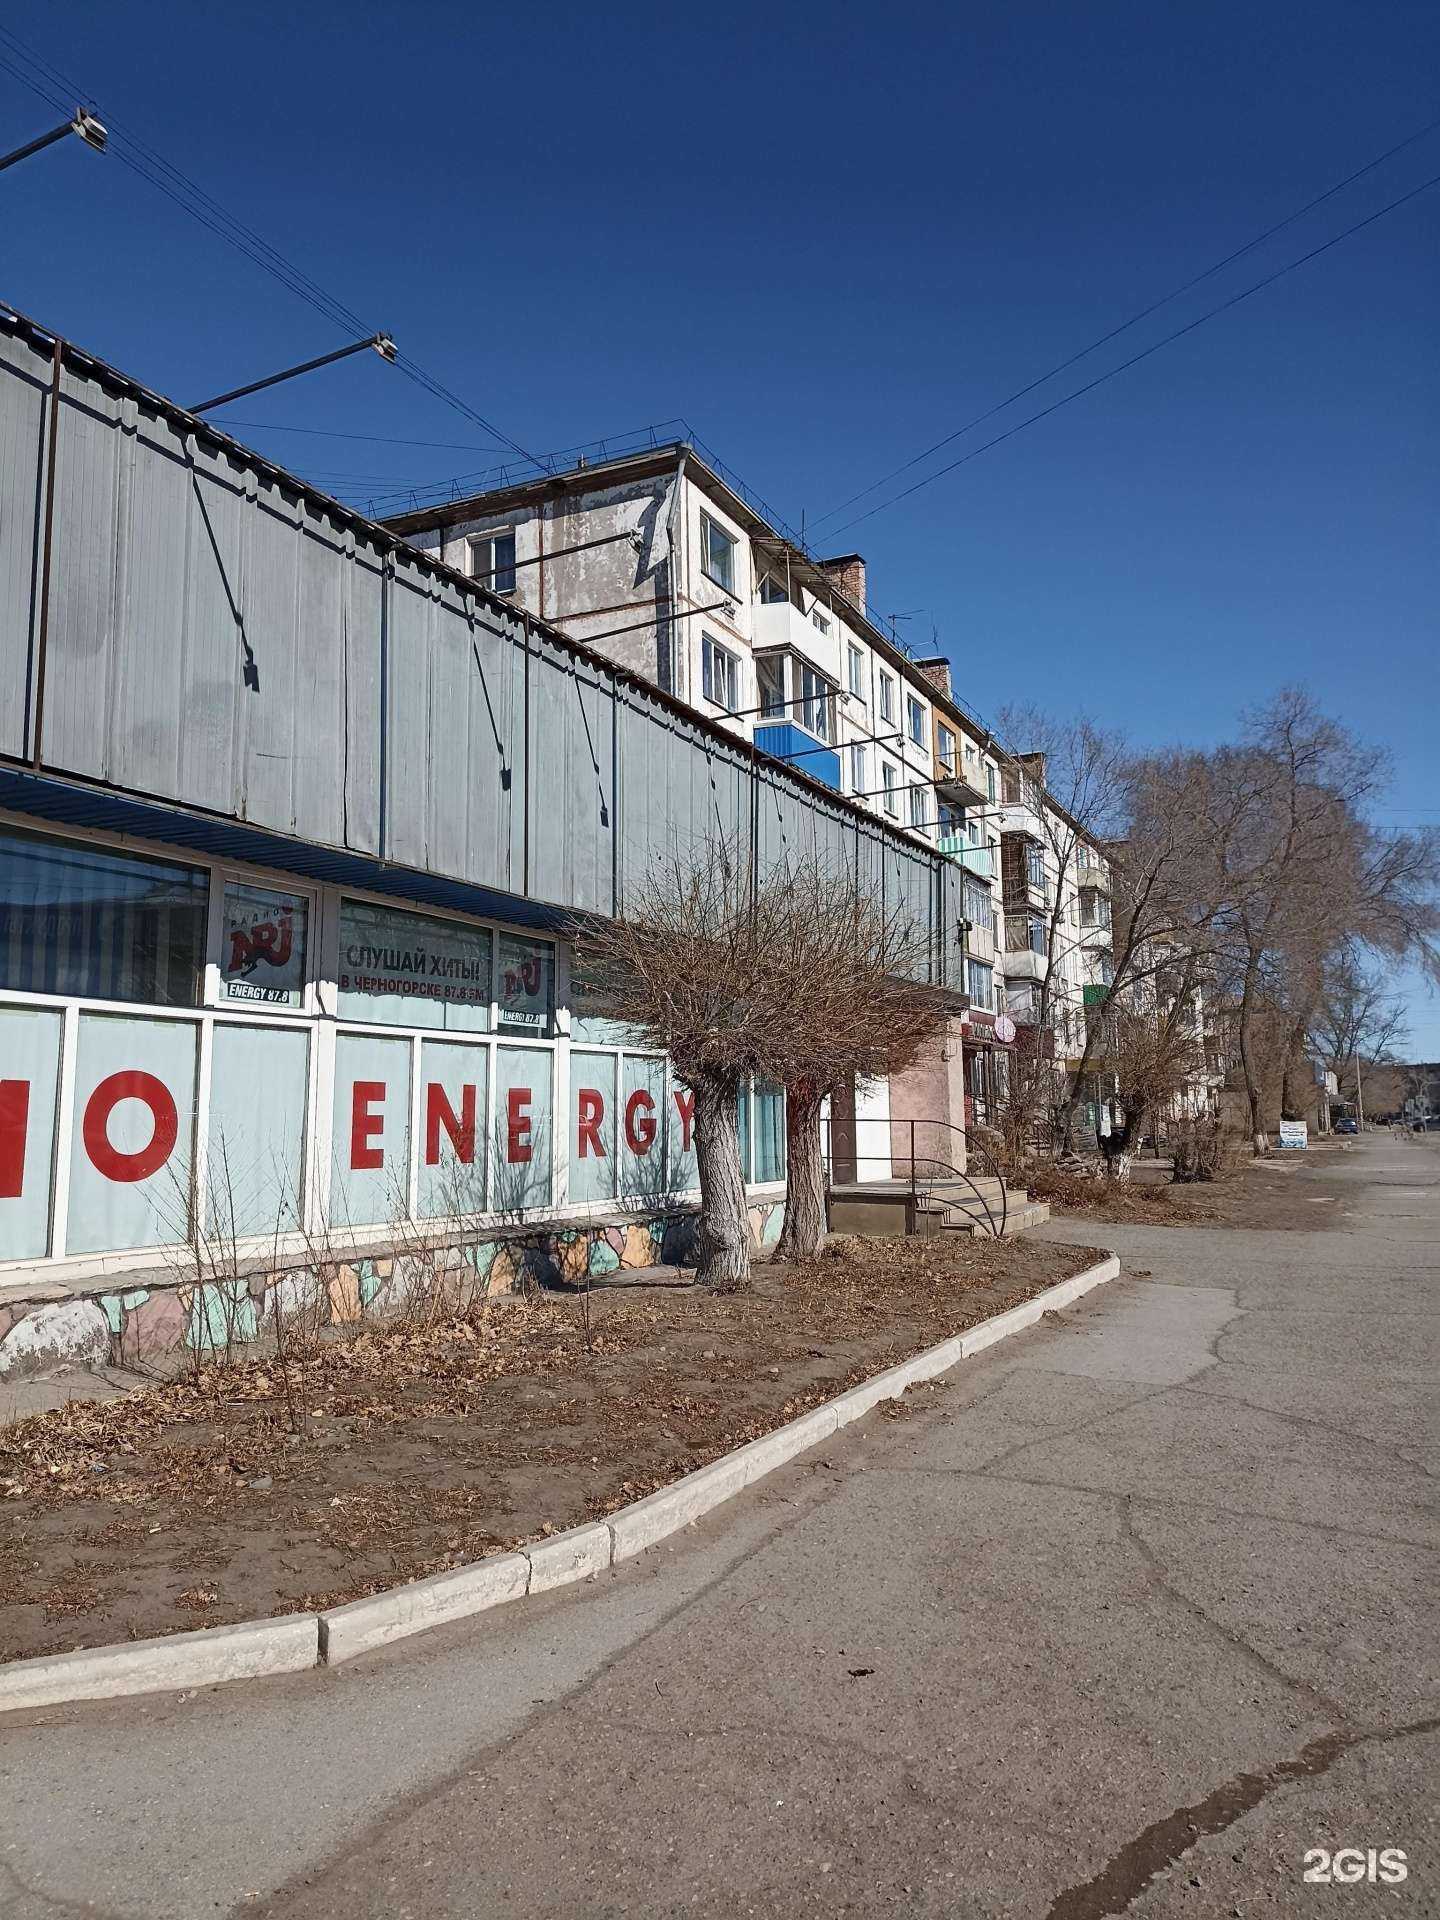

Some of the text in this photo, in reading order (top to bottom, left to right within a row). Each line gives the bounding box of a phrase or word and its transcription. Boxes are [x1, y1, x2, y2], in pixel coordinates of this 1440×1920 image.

[347, 945, 426, 975] СЛУШАЙ
[430, 954, 480, 982] ХИТЫ!
[229, 984, 289, 1003] ENERGY 87.8
[341, 974, 349, 989] В
[354, 975, 441, 996] ЧЕРНОГОРСКЕ
[350, 1080, 696, 1170] ENERGY
